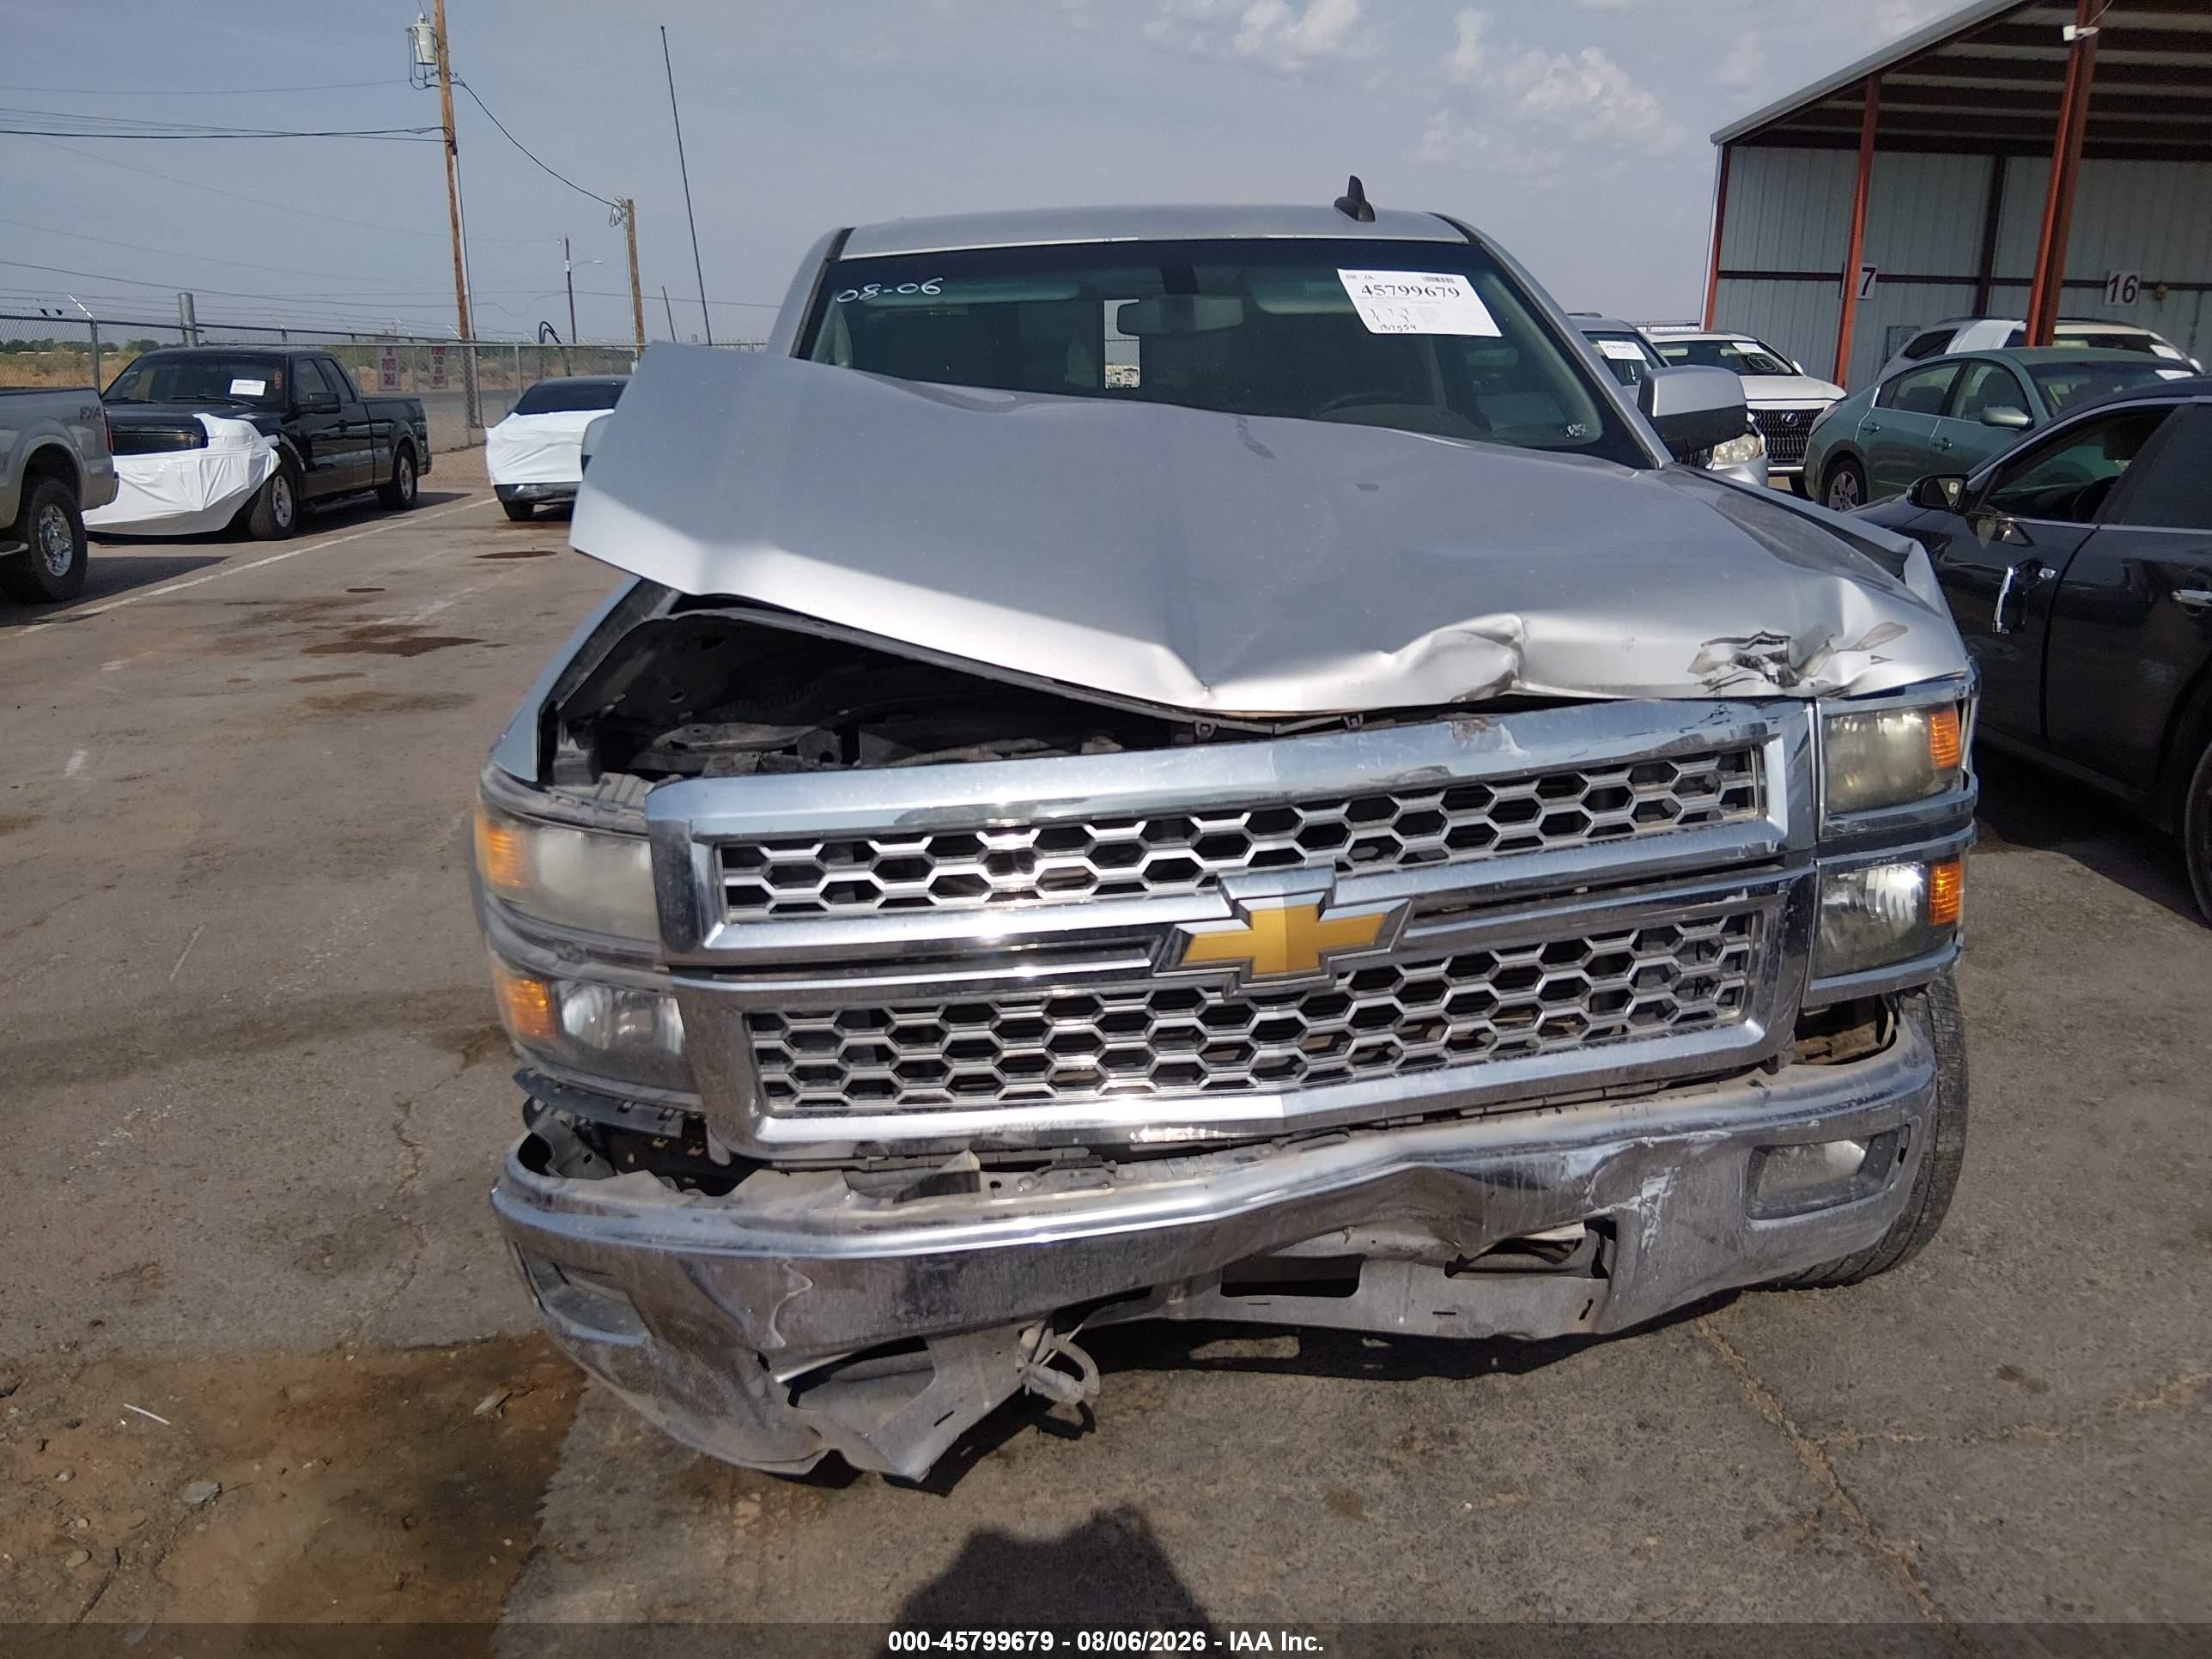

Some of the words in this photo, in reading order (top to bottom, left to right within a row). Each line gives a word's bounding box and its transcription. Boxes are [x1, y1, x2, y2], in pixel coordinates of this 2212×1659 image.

[836, 276, 944, 302] 08-06
[1361, 284, 1461, 298] 45799679
[2108, 274, 2138, 303] 16
